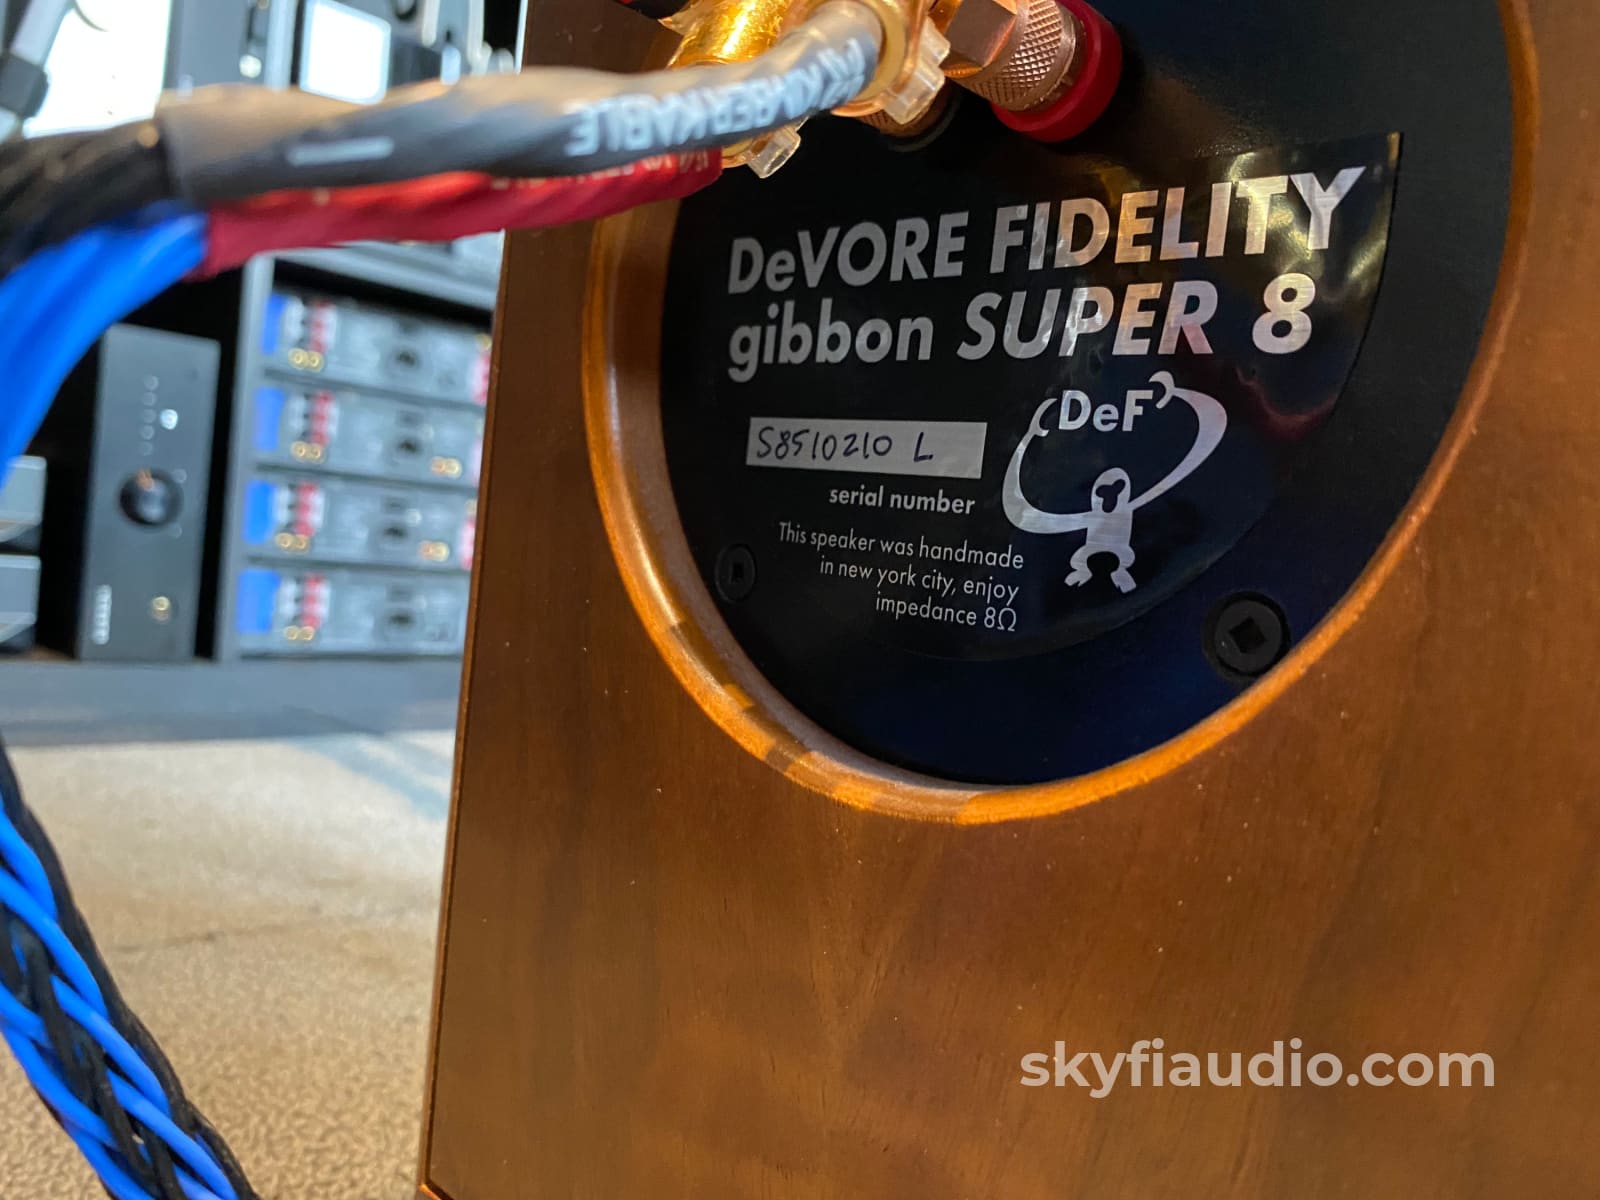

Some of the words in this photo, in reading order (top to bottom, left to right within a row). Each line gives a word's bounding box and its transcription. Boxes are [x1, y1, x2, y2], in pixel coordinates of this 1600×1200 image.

[728, 211, 970, 294] DeVORE
[989, 166, 1366, 274] FIDELITY
[728, 298, 935, 383] gibbon
[957, 280, 1219, 361] SUPER
[1252, 273, 1316, 355] 8
[1058, 389, 1154, 432] DeF
[757, 426, 893, 461] S8510210
[913, 431, 934, 463] L
[828, 484, 885, 508] serial
[889, 488, 976, 514] number
[778, 521, 807, 544] This
[810, 528, 876, 552] speaker
[880, 542, 914, 557] was
[919, 535, 1025, 570] handmade
[819, 555, 834, 576] in
[838, 565, 874, 580] new
[876, 564, 917, 587] york
[921, 568, 957, 598] city,
[962, 576, 1019, 607] enjoy
[875, 591, 978, 621] impedance
[983, 606, 1017, 632] 8Ω
